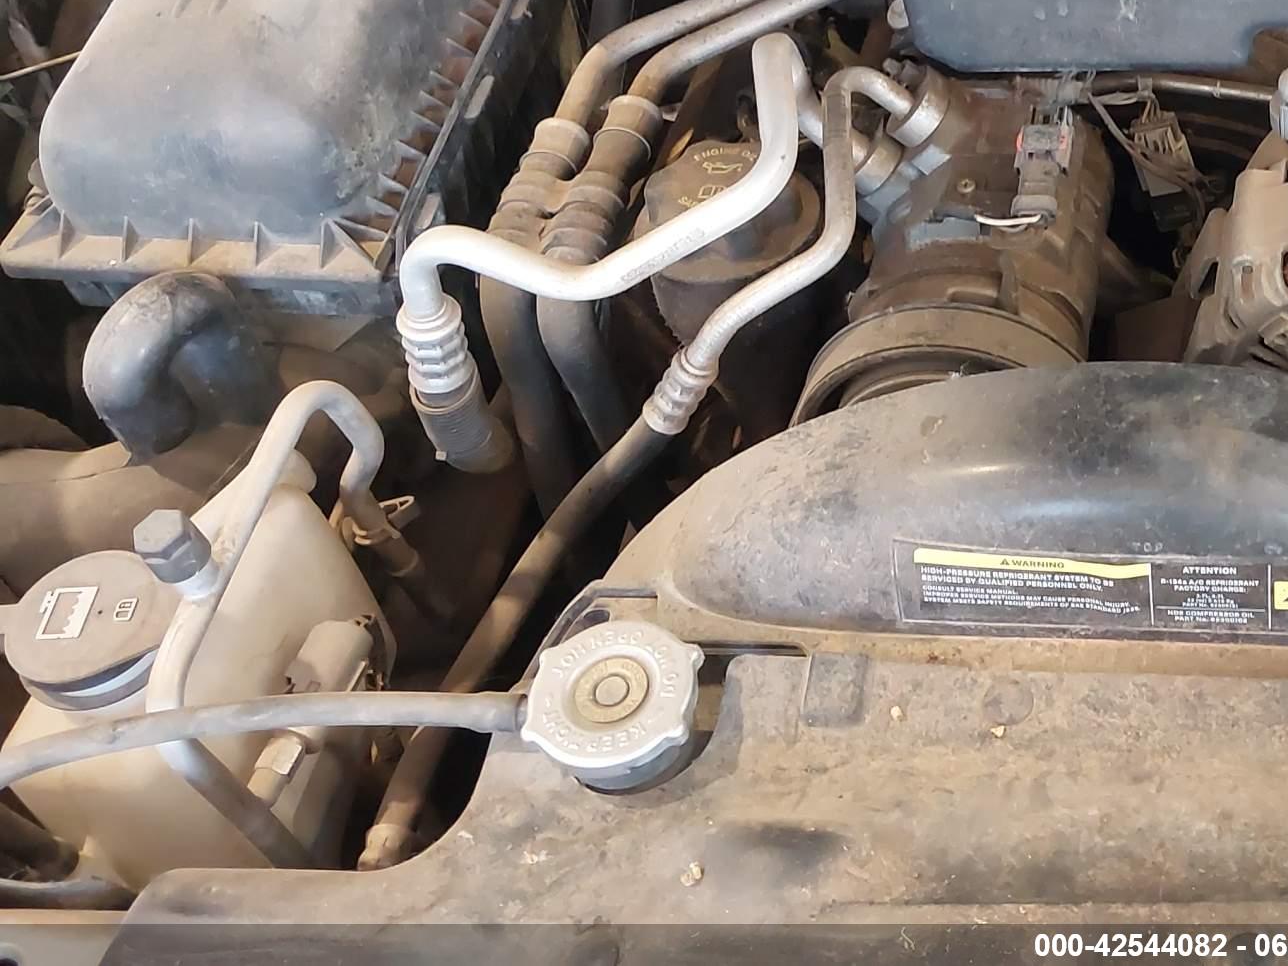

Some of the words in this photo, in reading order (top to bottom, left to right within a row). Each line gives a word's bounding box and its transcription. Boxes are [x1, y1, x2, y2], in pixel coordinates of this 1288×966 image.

[1012, 559, 1065, 568] WARNING
[920, 566, 991, 578] HIGH-PRESSURE
[992, 571, 1052, 581] REFRIGERANT
[1054, 575, 1088, 583] SYSTEM
[1182, 566, 1237, 575] ATTENTION
[921, 574, 964, 584] SERVICED
[965, 577, 976, 585] BY
[978, 578, 1024, 587] QUALIFIED
[1026, 580, 1077, 588] PERSONNEL
[1079, 582, 1103, 592] ONLY.
[1205, 579, 1259, 587] REFRIGERANT
[584, 721, 646, 752] KEEP
